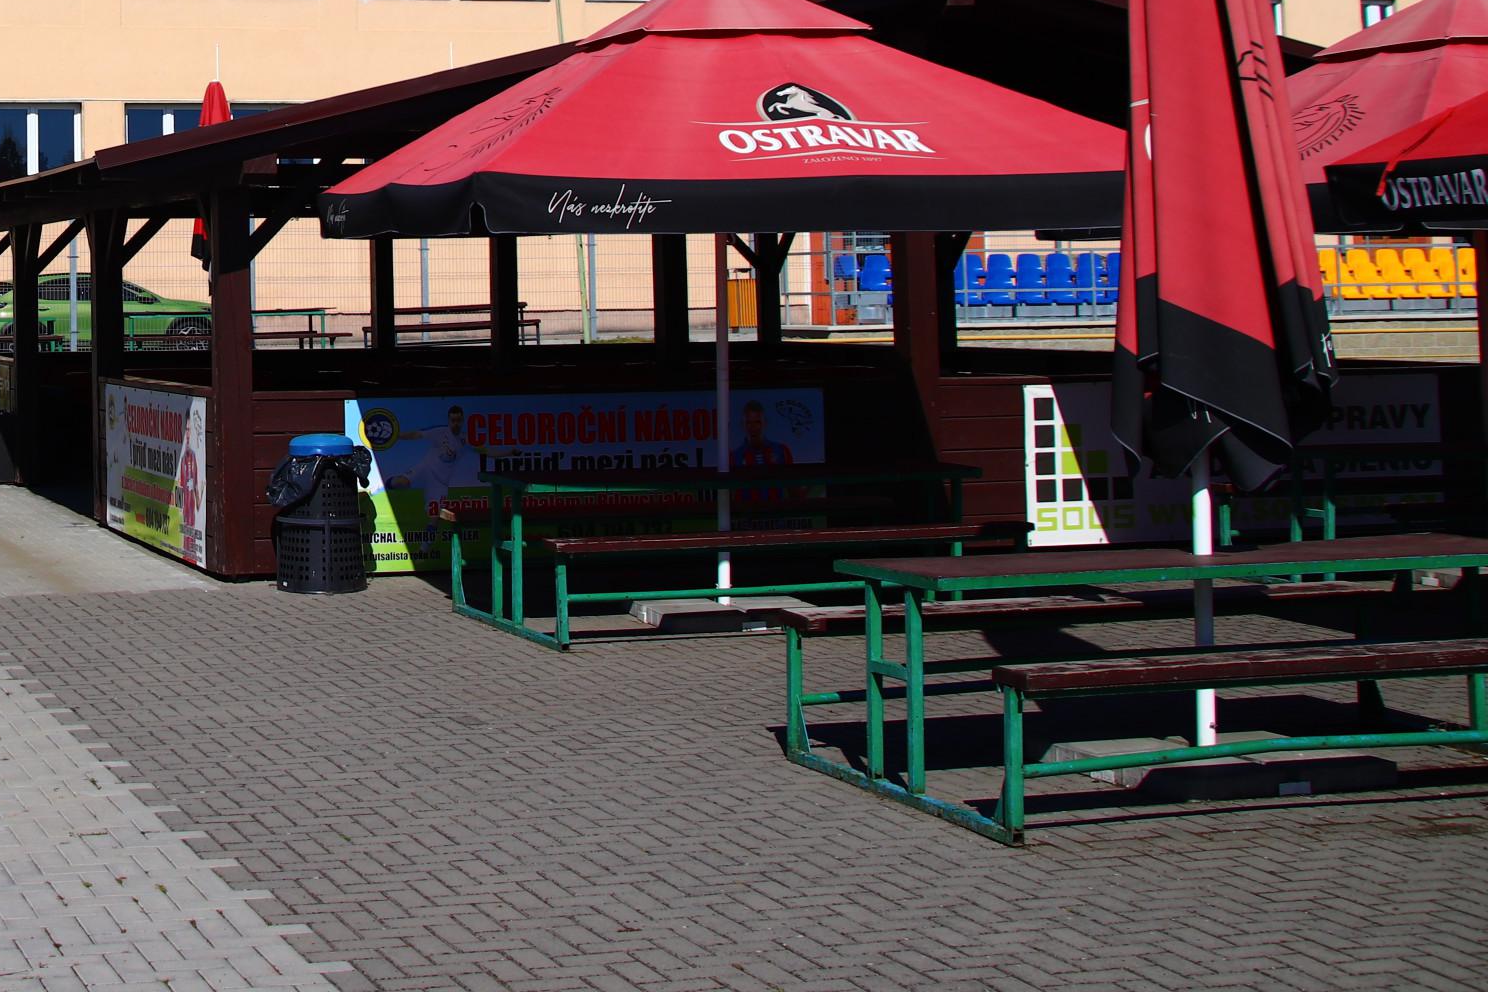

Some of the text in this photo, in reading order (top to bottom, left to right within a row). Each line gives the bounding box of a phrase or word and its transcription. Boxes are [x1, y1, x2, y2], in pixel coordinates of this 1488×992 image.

[718, 124, 937, 154] OSTRAVAR
[1380, 167, 1488, 212] OSTRAVAR
[467, 404, 626, 446] CELOROČNÍ
[1326, 403, 1431, 431] PRAVY
